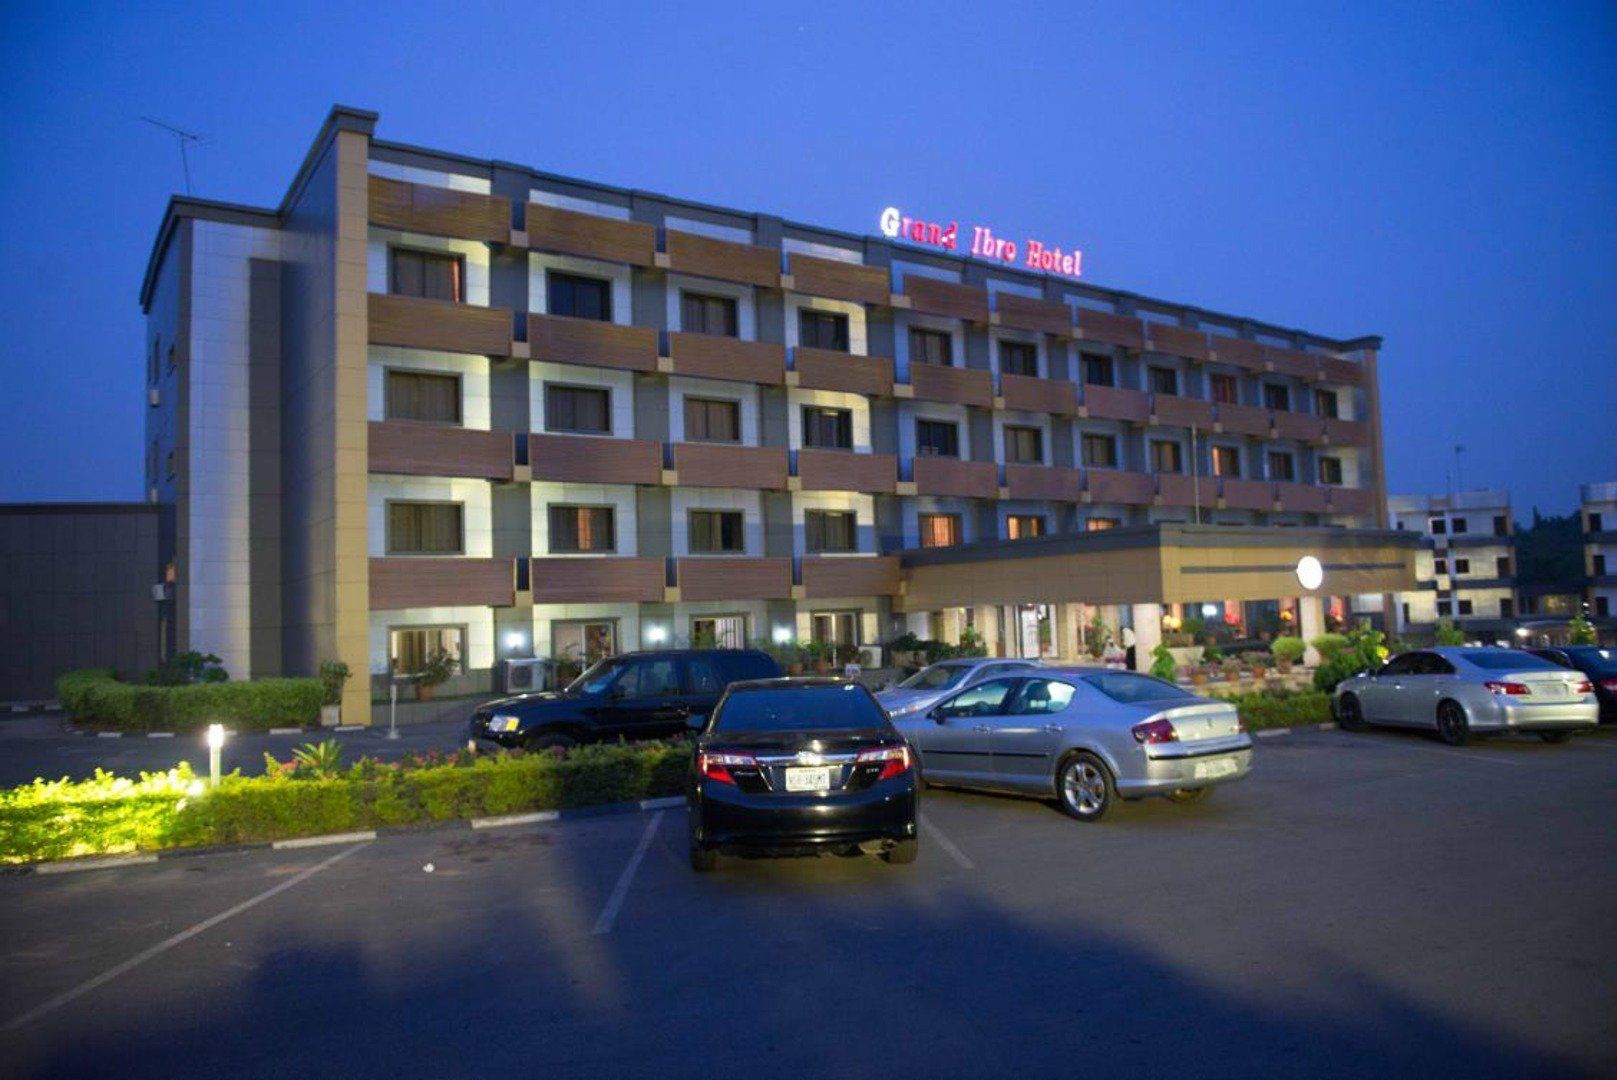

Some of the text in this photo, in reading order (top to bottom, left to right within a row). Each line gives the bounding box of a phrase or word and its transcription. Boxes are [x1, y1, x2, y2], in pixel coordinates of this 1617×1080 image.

[880, 207, 1083, 276] Grand Ibro Hotel
